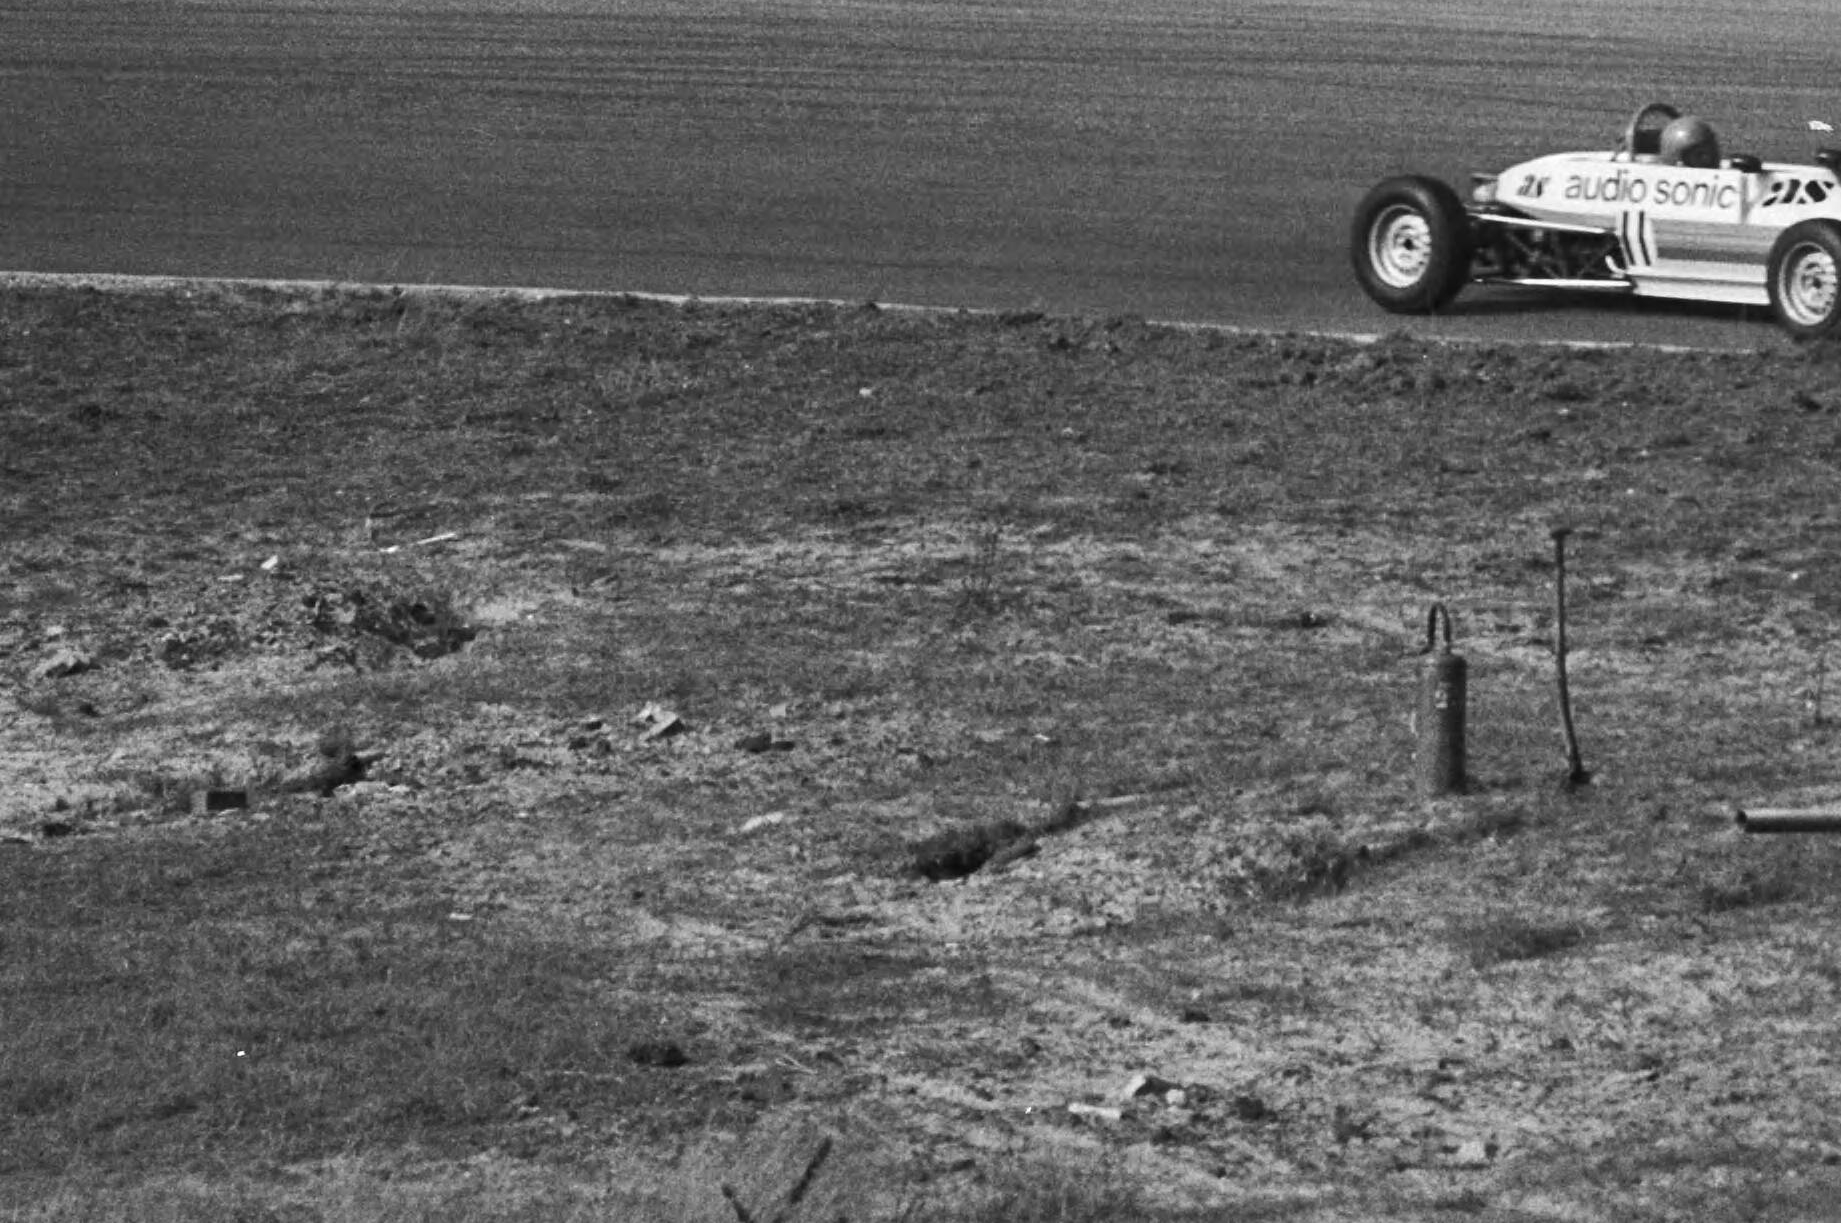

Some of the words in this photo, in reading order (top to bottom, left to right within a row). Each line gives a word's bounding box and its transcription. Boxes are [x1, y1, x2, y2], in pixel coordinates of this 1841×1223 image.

[1564, 169, 1647, 203] audio
[1653, 174, 1737, 209] sonic
[1622, 210, 1652, 267] 11
